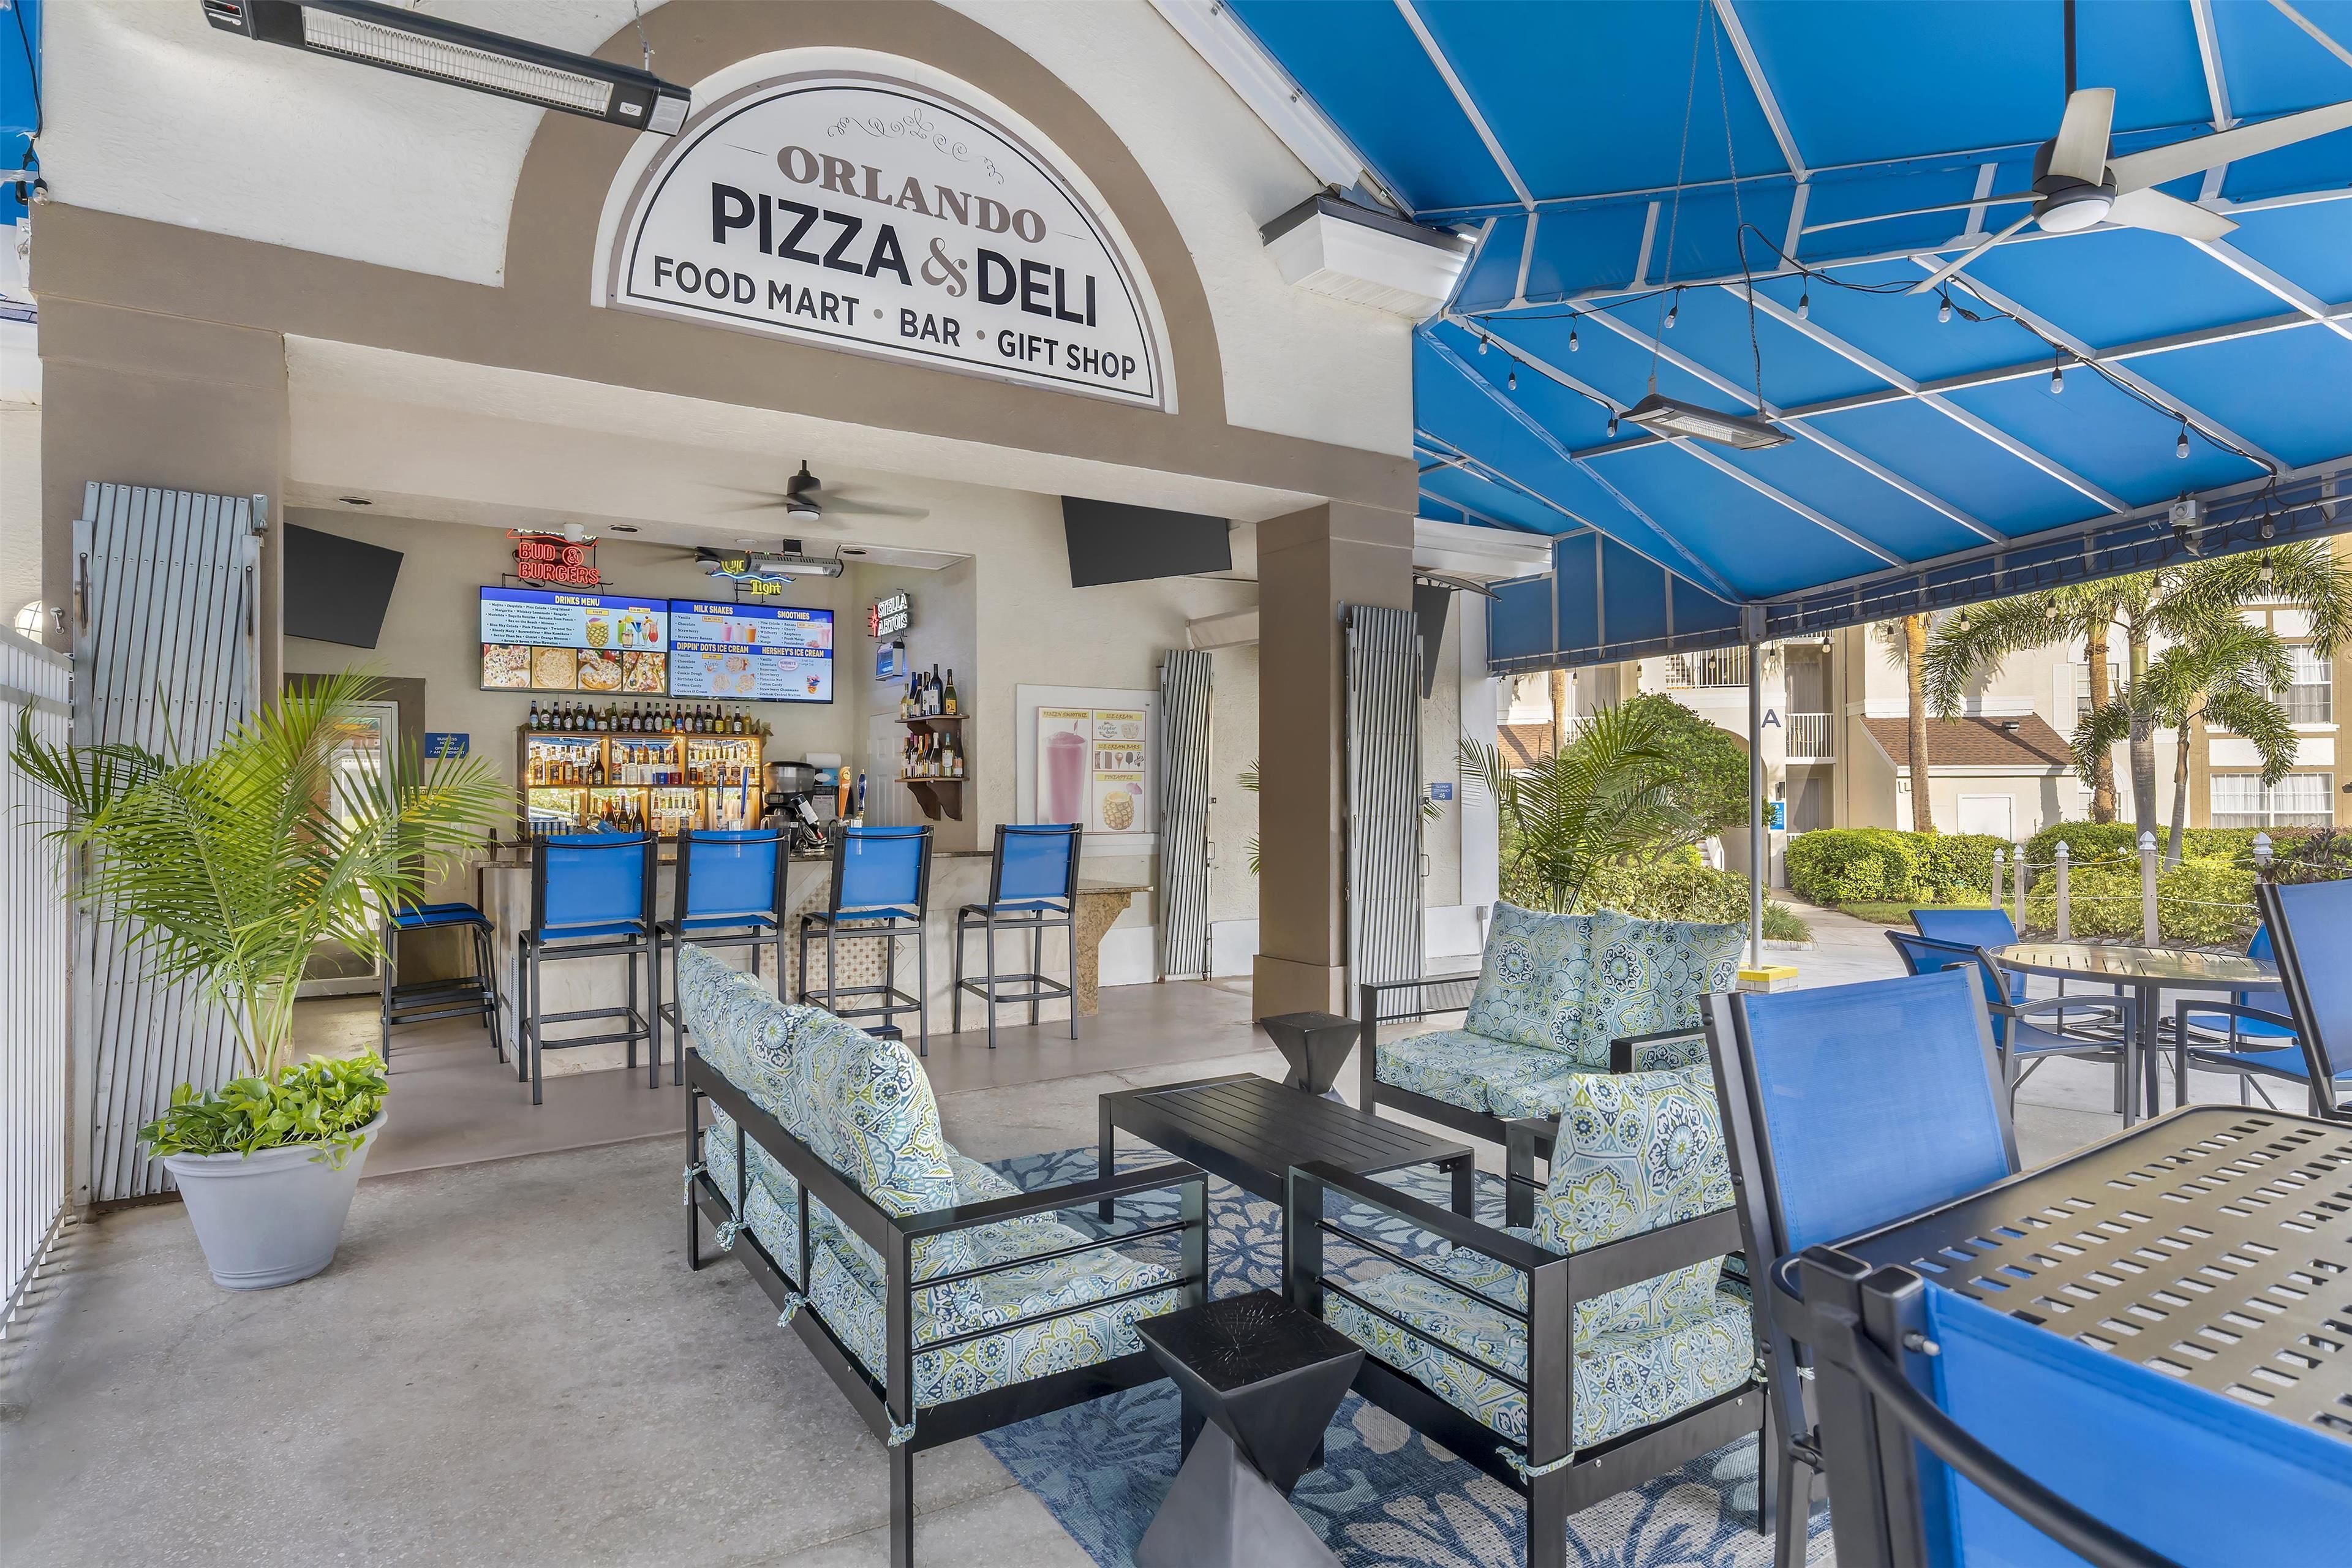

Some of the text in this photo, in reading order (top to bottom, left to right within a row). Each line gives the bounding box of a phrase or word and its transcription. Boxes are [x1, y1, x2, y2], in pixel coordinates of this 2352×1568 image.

[777, 145, 1047, 244] ORLANDO
[711, 182, 1096, 328] PIZZA & DELI
[654, 255, 1136, 382] FOOD MART BAR GIFT SHOP
[519, 542, 579, 564] BUD &
[519, 562, 599, 584] BURGERS
[555, 595, 600, 606] DRINKS MENU
[694, 605, 733, 615] MILK SHAKES
[878, 593, 908, 618] STELLA
[777, 611, 810, 620] SMOOTHIES
[878, 611, 907, 636] ARTOIS
[677, 642, 699, 650] DIPPIN'
[701, 643, 716, 652] DOTS
[762, 647, 793, 655] HERSHEY'S
[1762, 709, 1781, 728] A
